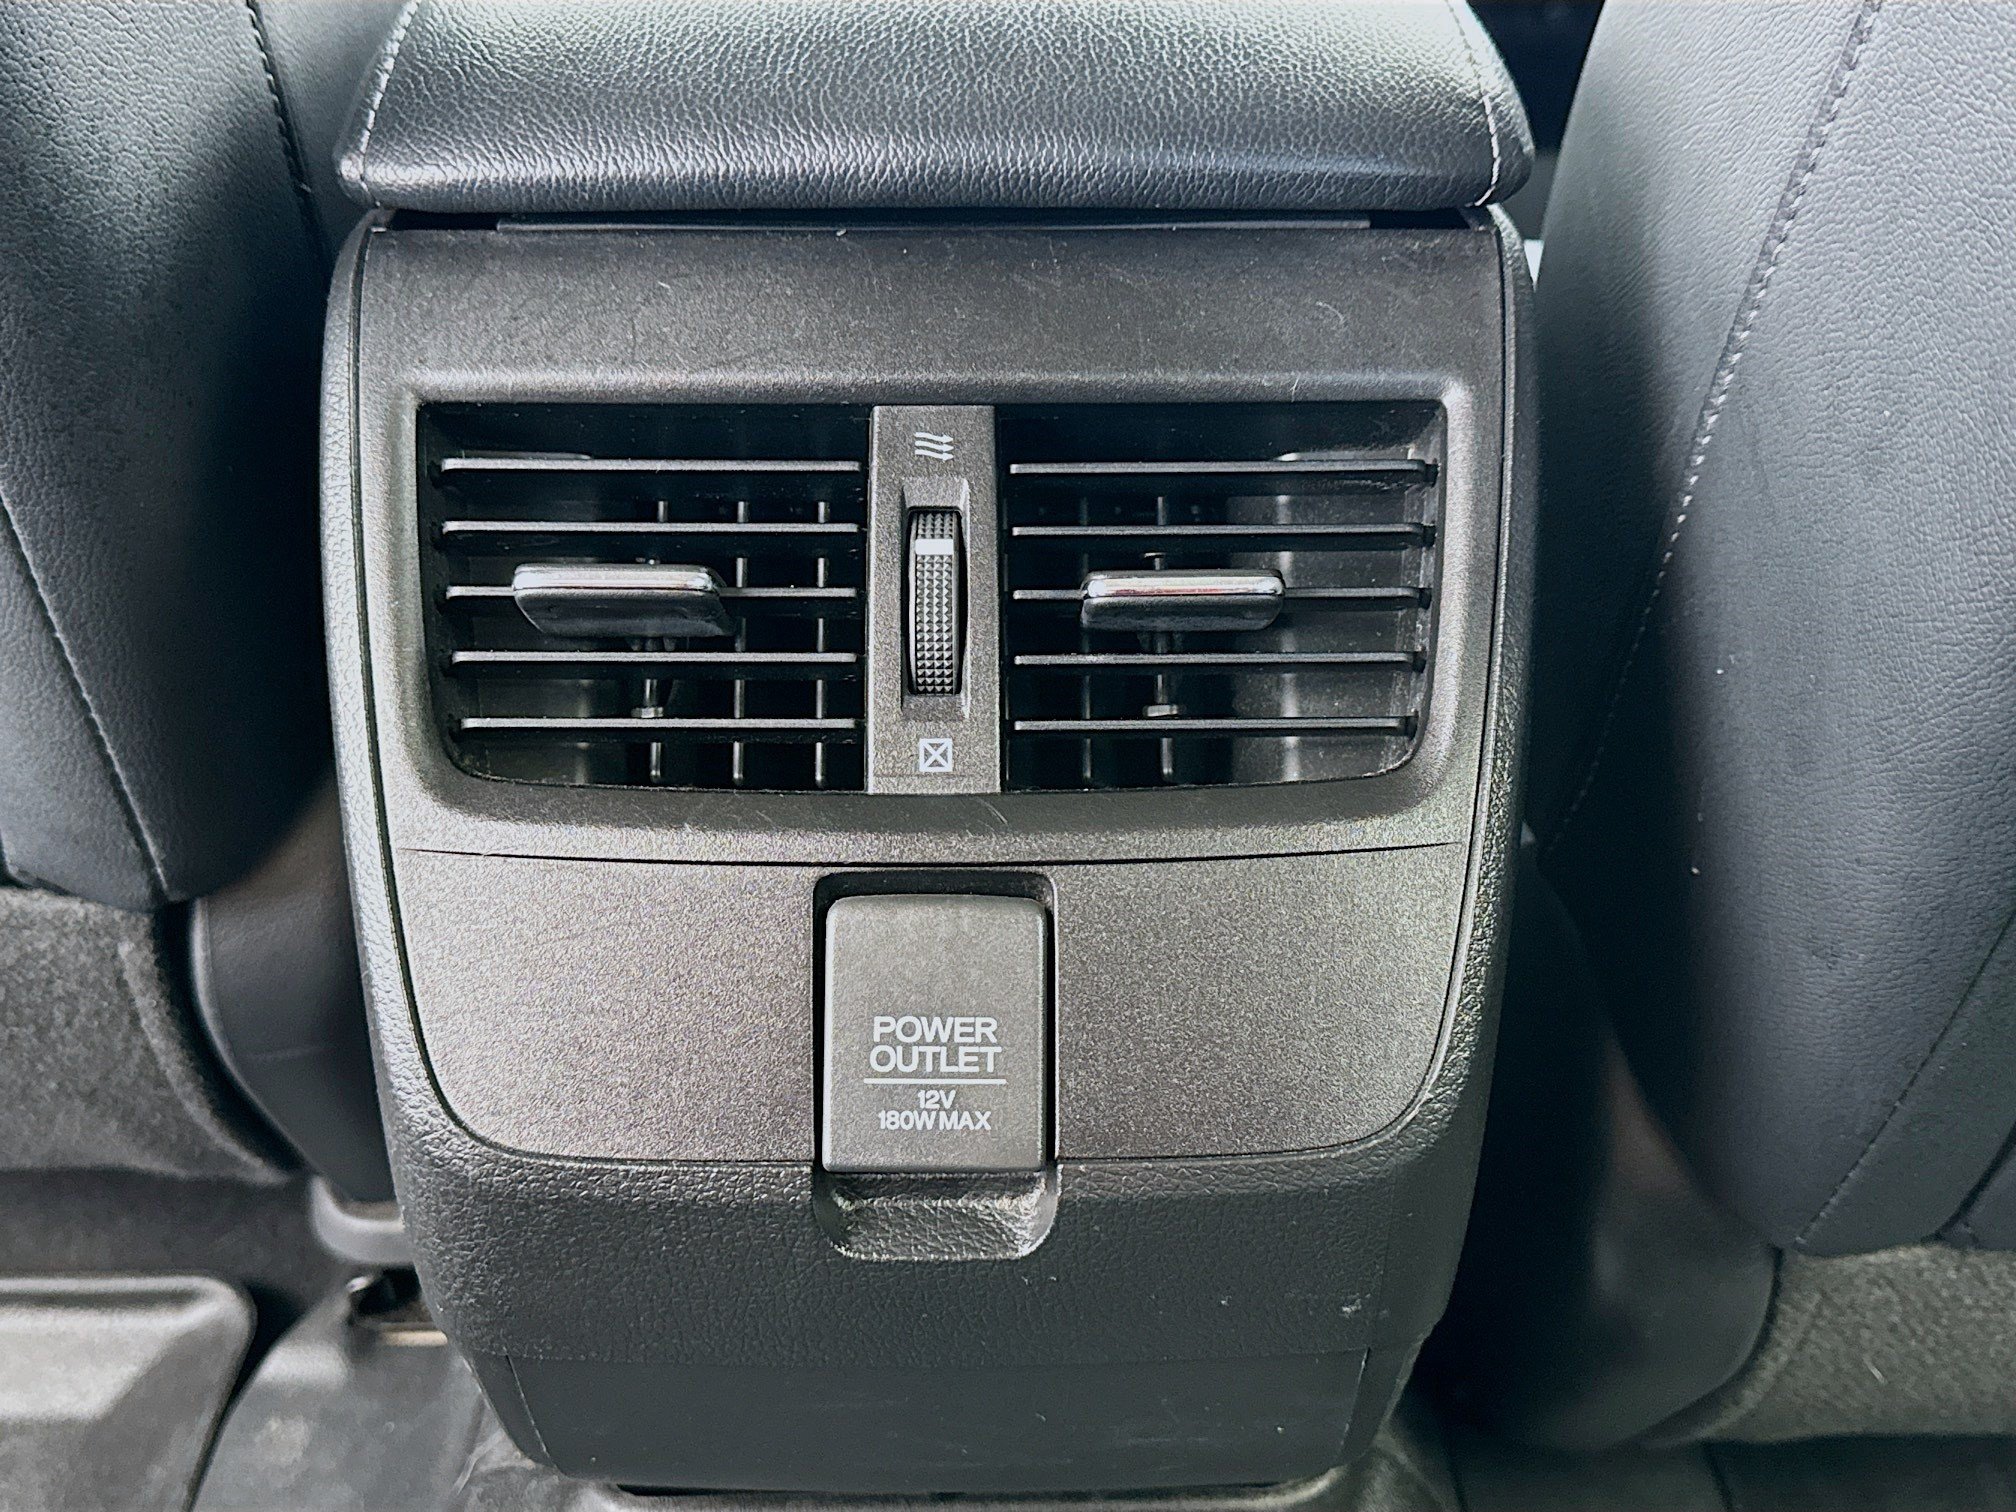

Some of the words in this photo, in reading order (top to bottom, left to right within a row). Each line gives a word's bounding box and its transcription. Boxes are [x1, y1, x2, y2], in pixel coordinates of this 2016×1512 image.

[873, 1016, 998, 1043] POWER
[869, 1045, 1002, 1072] OUTLET
[918, 1089, 956, 1109] 12V
[878, 1110, 937, 1130] 180W
[939, 1111, 992, 1130] MAX
